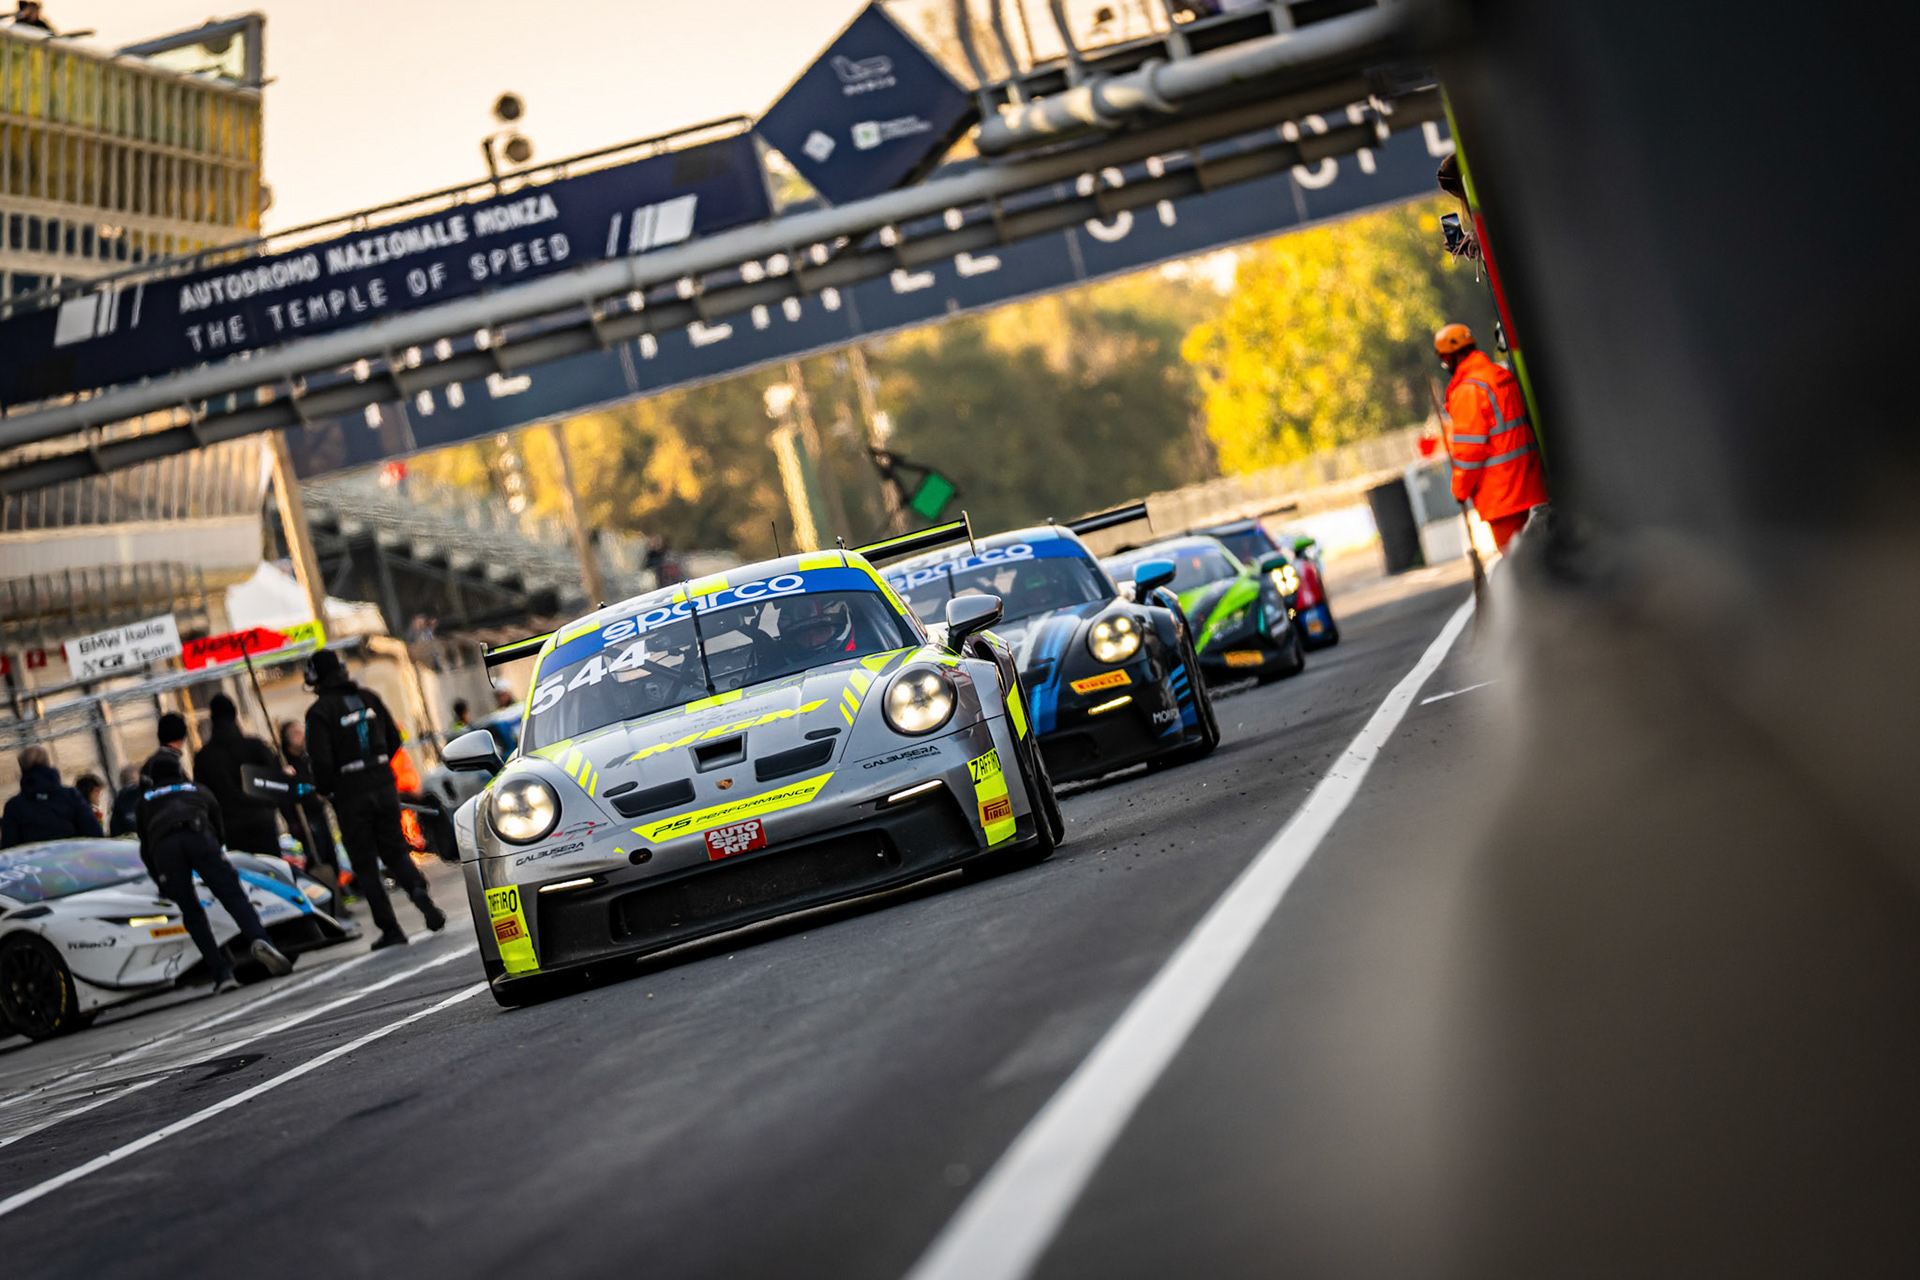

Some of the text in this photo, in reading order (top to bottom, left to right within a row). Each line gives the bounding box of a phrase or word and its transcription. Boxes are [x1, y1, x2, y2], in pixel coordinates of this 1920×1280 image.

[179, 193, 559, 314] AUTODROMO NAZIONALE MONZA
[185, 233, 570, 352] THE TEMPLE OF SPEED
[602, 574, 806, 648] sparco
[530, 640, 651, 716] 544
[862, 745, 939, 769] GALBUSERA
[982, 799, 1011, 821] PIRELLI
[707, 821, 760, 843] AUTO
[711, 831, 760, 850] SPRI
[515, 841, 585, 867] GALBUSERA
[724, 841, 751, 856] NT
